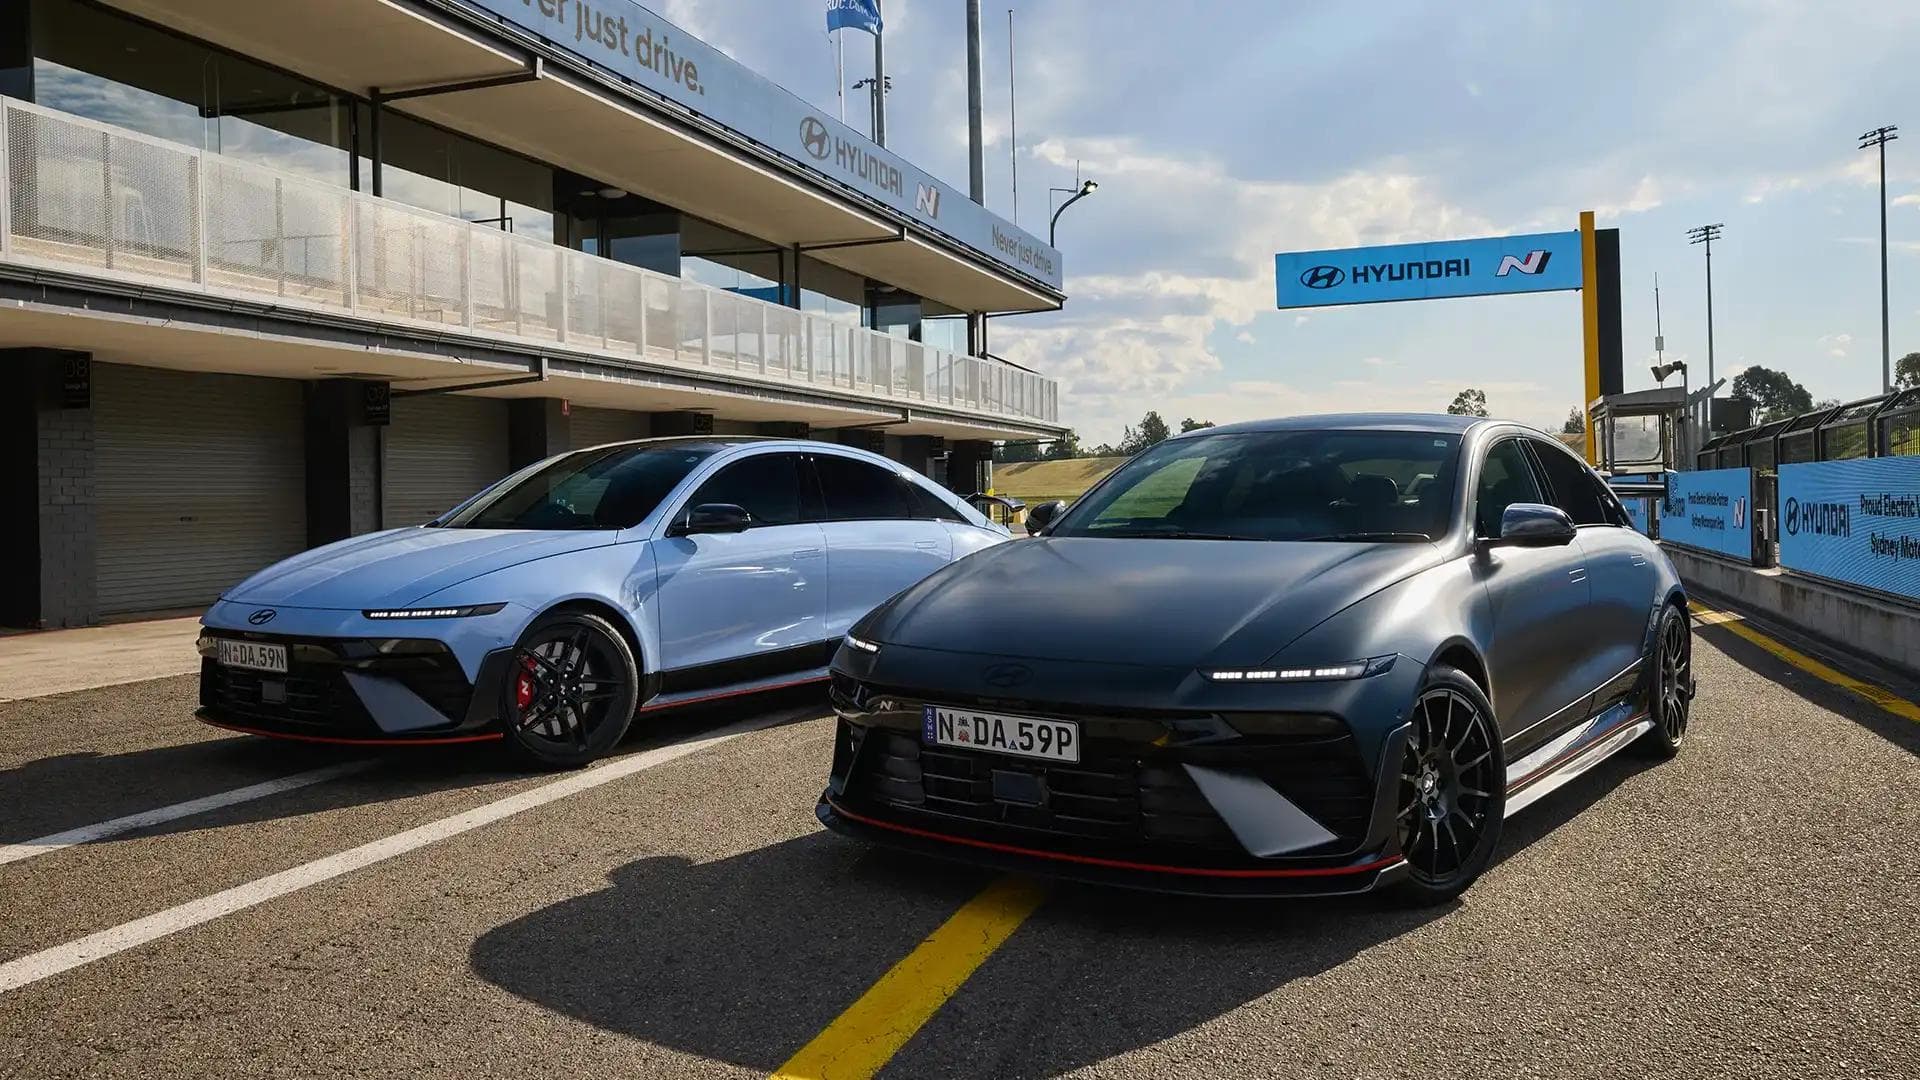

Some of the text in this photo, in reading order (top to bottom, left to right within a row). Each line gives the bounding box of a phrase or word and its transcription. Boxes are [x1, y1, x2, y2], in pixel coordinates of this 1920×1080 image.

[575, 0, 629, 57] just
[635, 28, 704, 96] drive.
[835, 136, 903, 198] HYUNDAI
[991, 223, 1017, 258] Never
[1352, 249, 1553, 284] HYUNDAI N
[1801, 503, 1850, 538] HYUNDAI
[1860, 493, 1883, 516] Proud
[1883, 493, 1915, 518] Electric
[1870, 530, 1899, 562] Sydney
